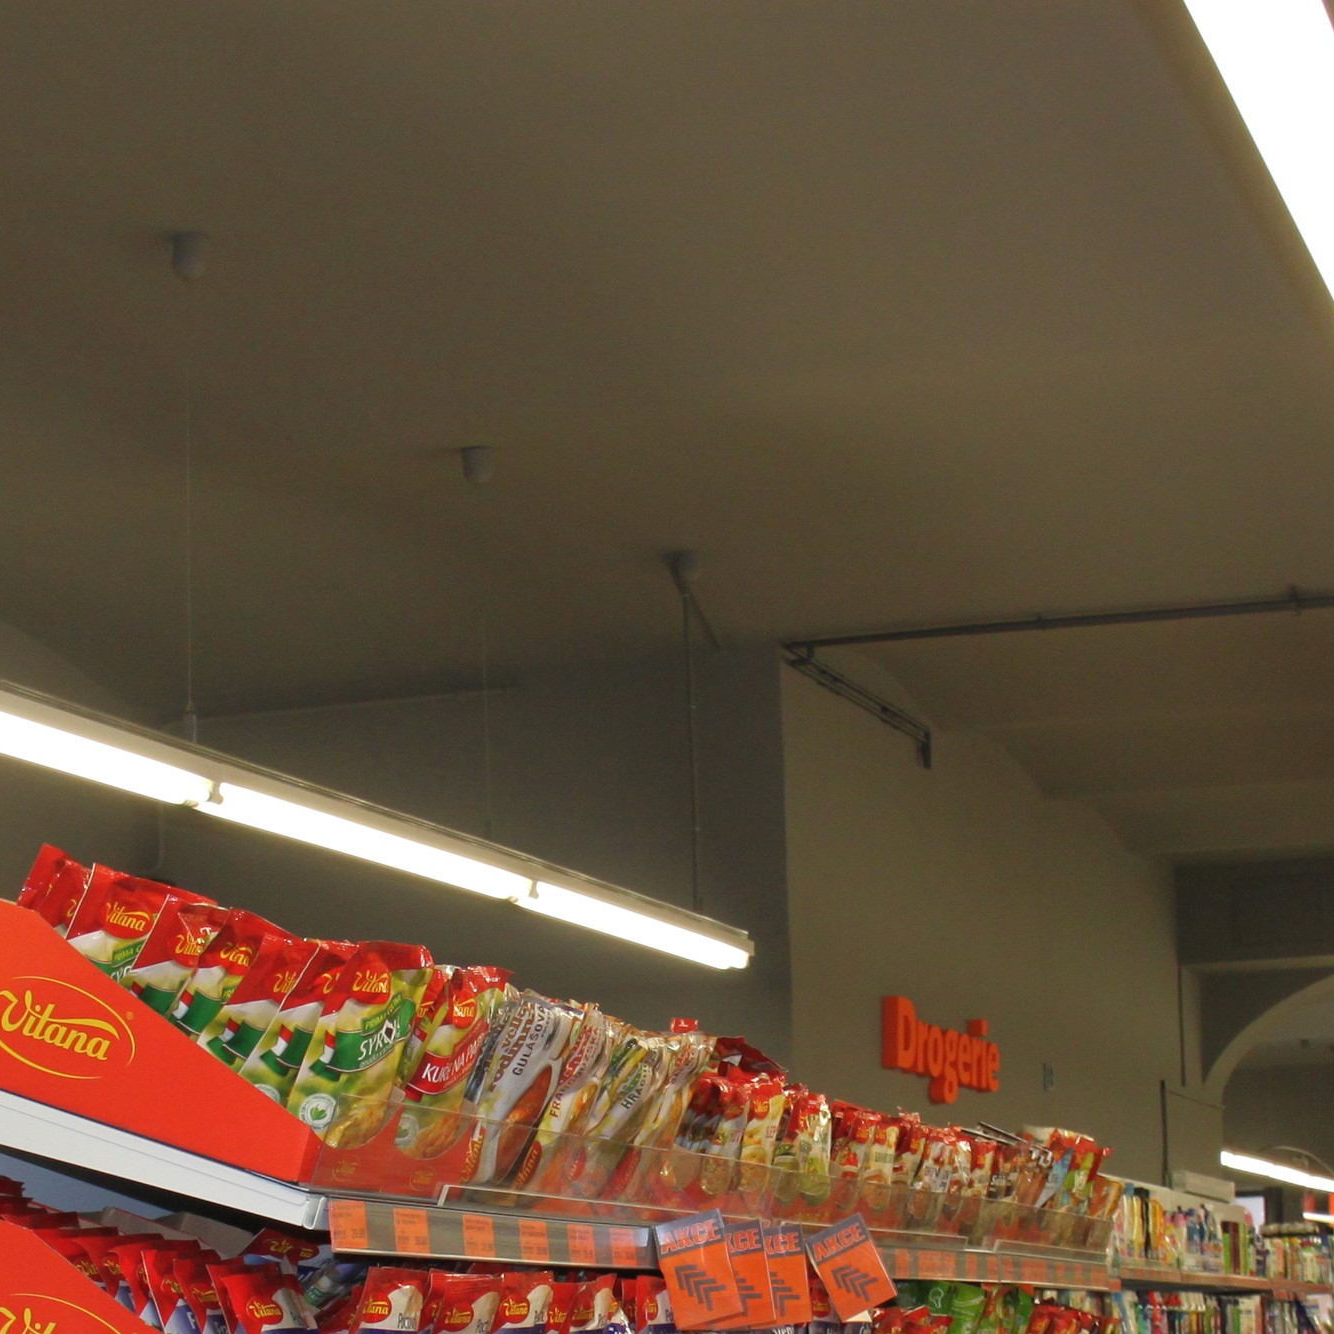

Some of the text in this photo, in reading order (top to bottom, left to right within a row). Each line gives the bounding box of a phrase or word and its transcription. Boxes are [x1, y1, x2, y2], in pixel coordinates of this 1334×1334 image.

[106, 901, 151, 932] Vitana
[881, 995, 1000, 1104] Drogerie
[660, 1219, 720, 1254] AKCE
[812, 1223, 866, 1263] AKCE
